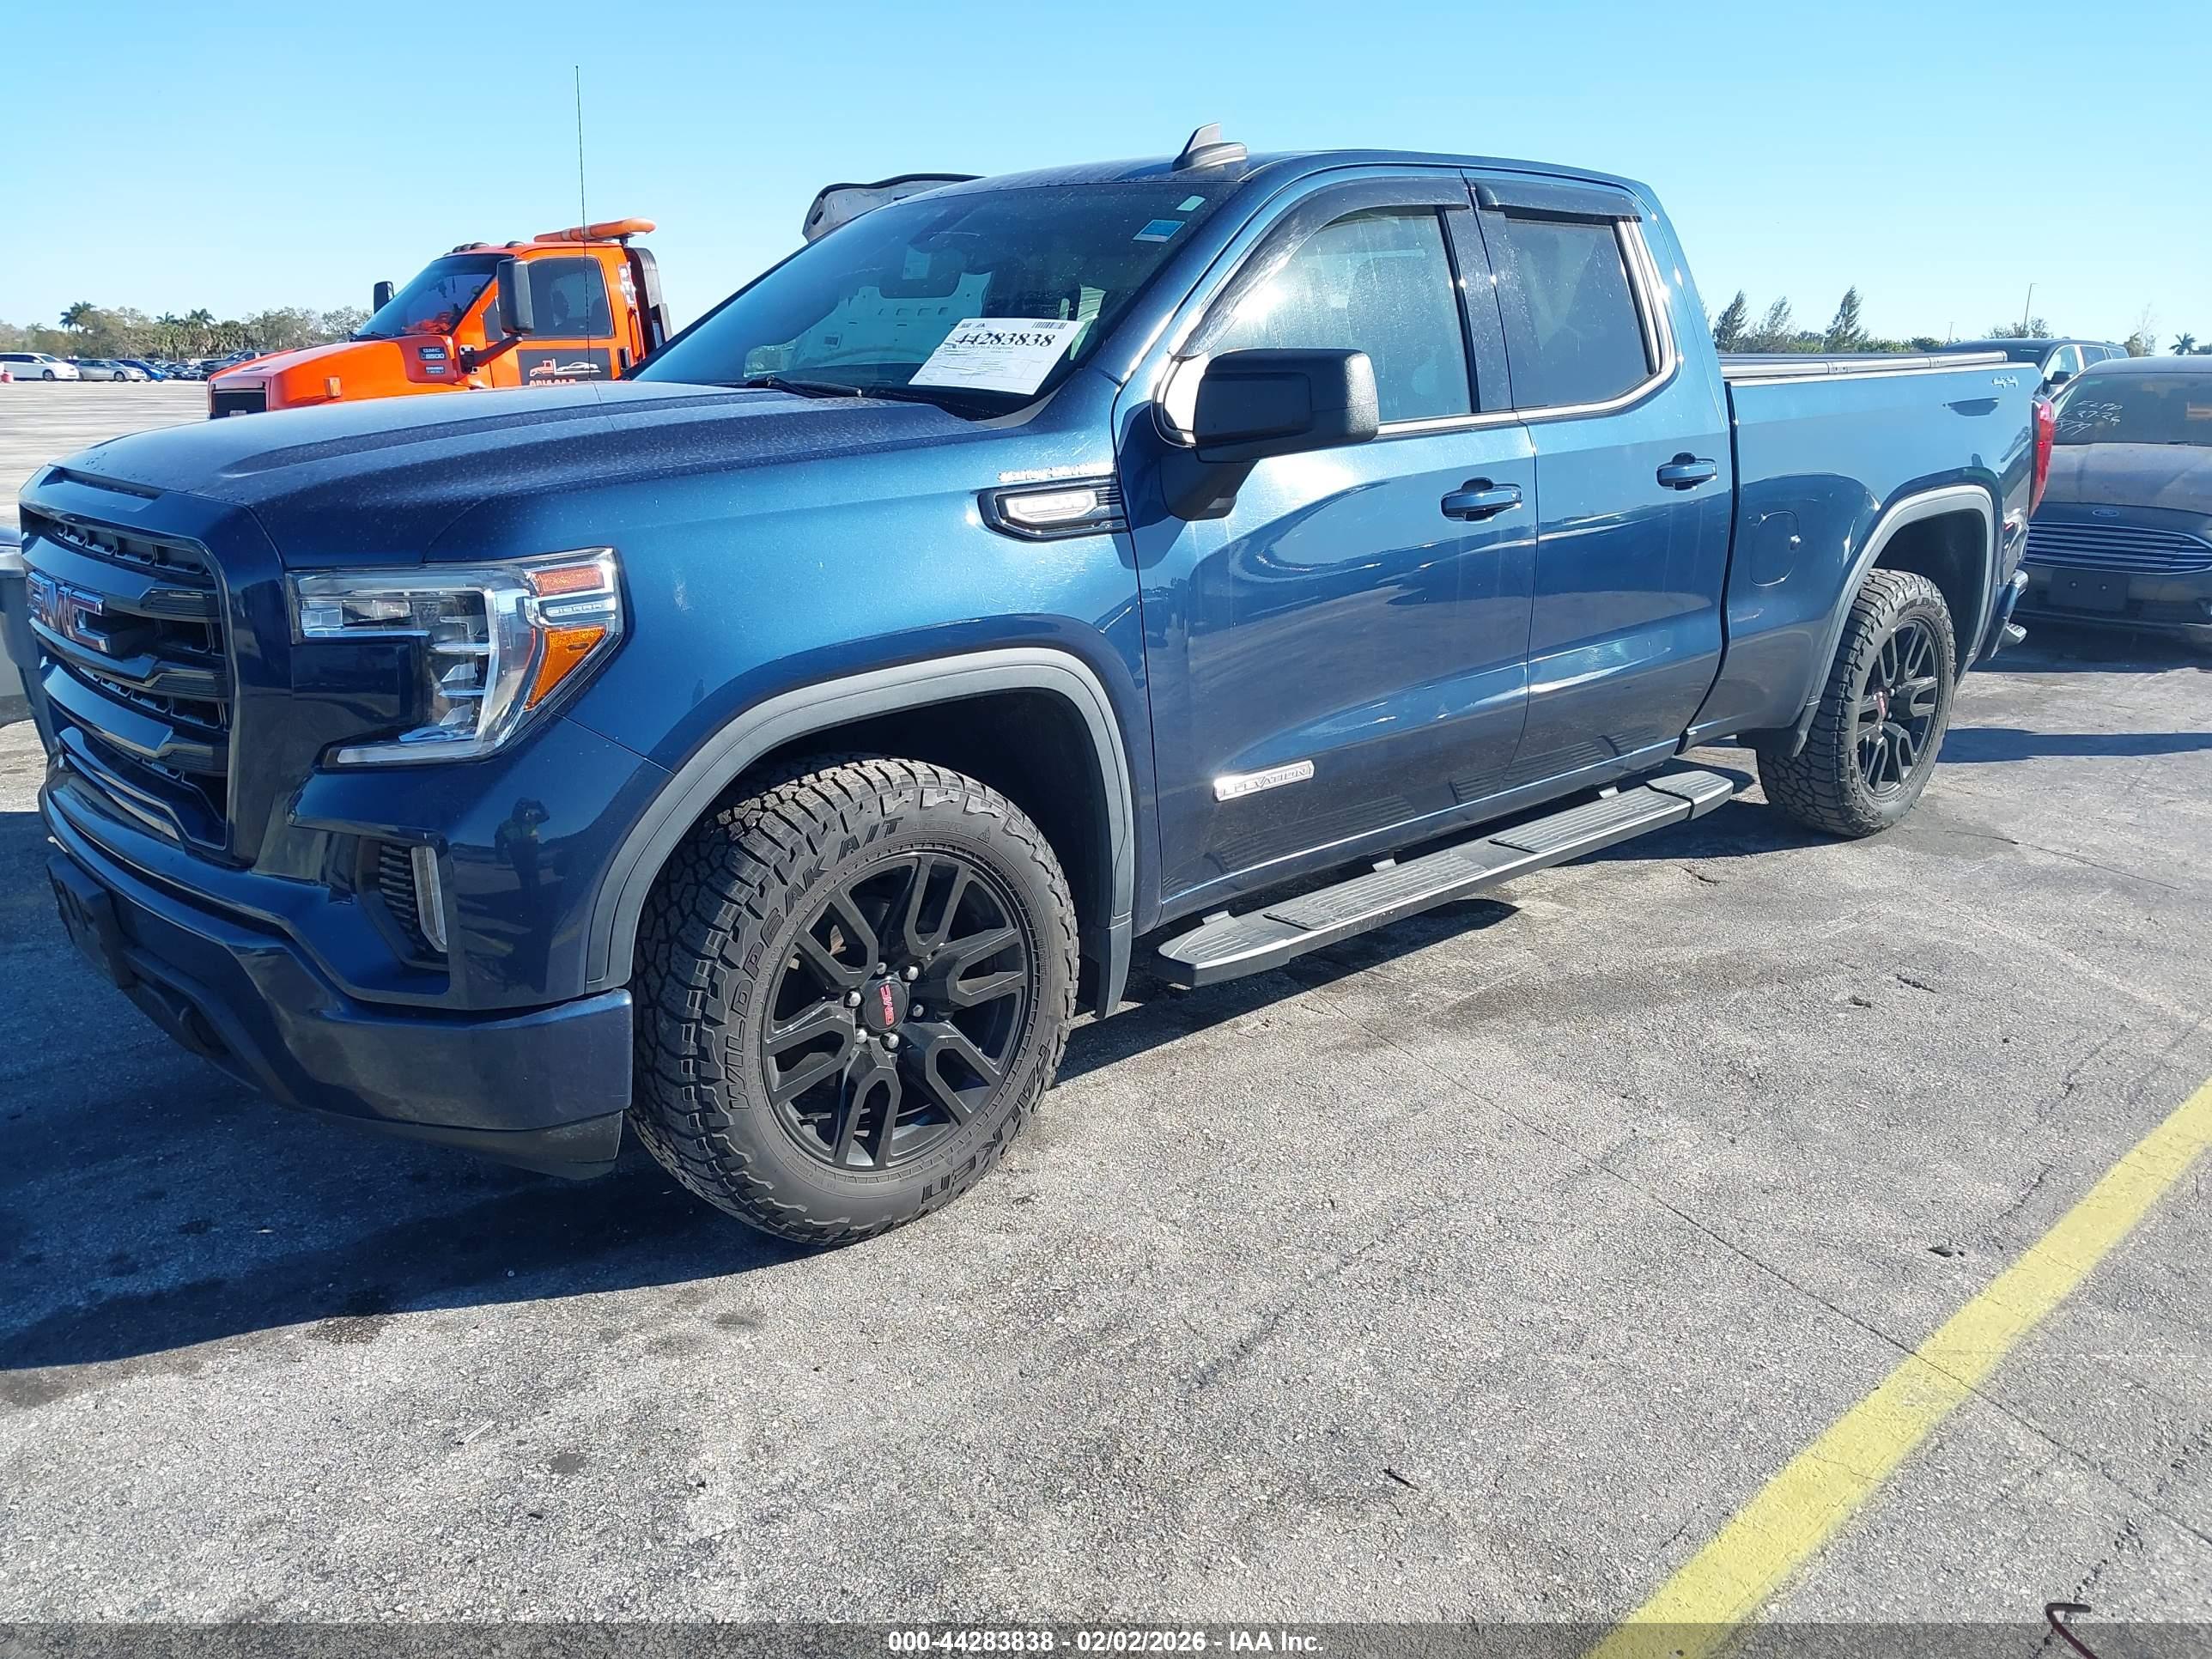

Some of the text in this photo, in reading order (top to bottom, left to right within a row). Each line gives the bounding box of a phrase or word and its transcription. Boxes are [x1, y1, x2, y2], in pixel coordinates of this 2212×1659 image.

[955, 331, 1056, 348] 44283838
[724, 855, 830, 1109] WILDPEAK
[880, 984, 895, 1025] GMC
